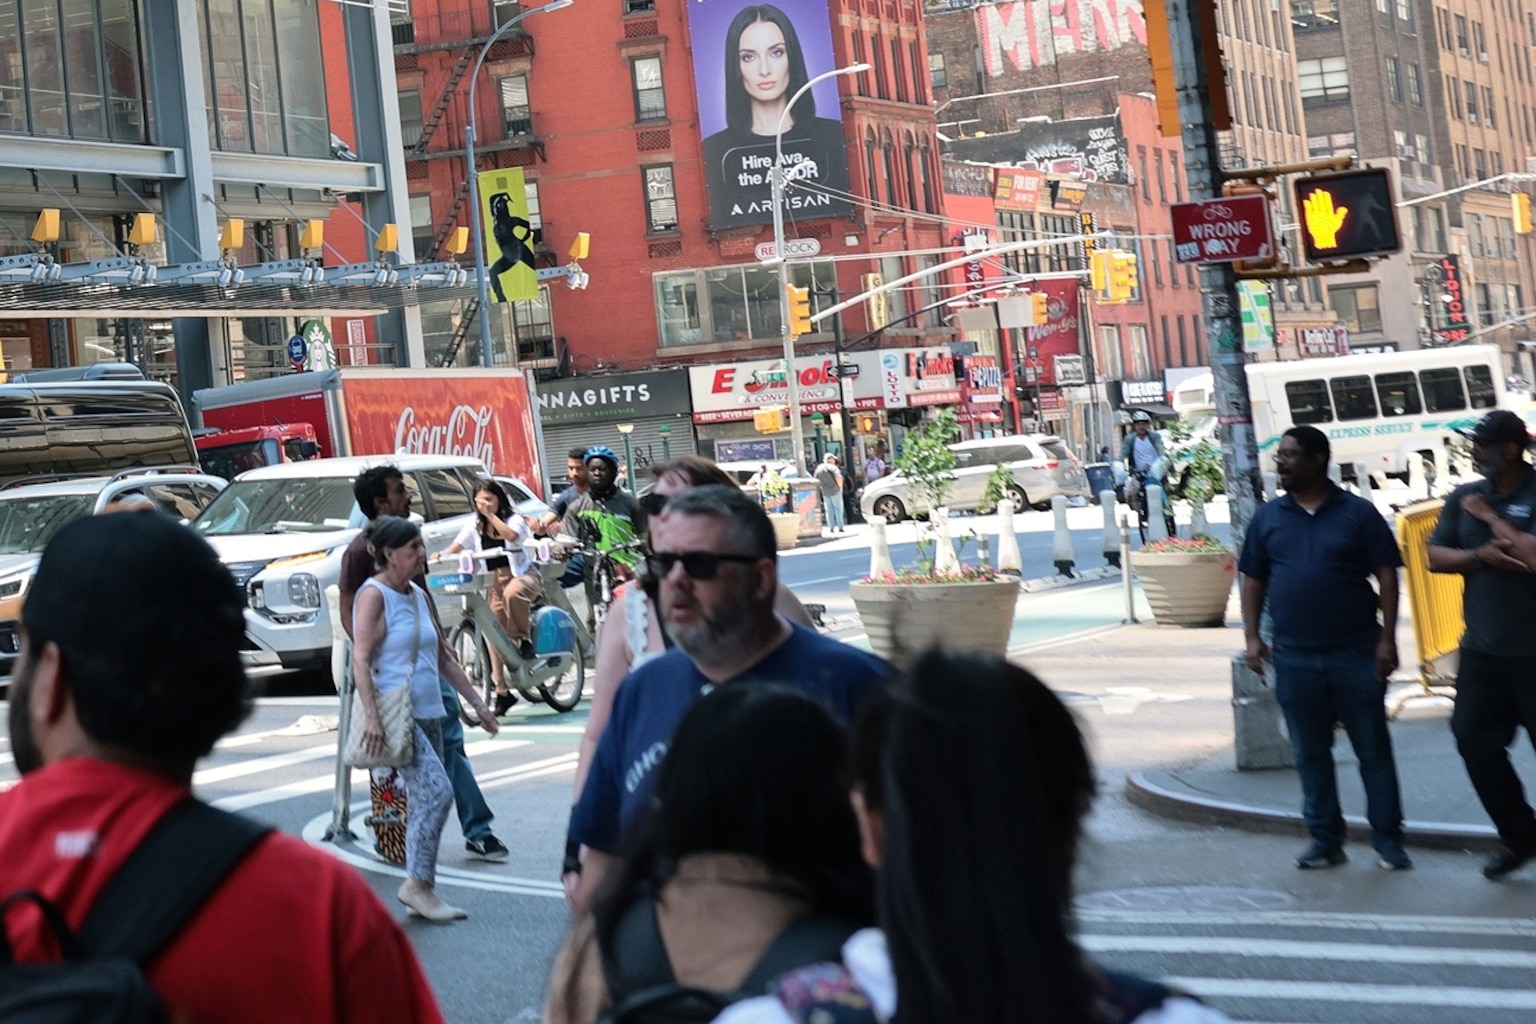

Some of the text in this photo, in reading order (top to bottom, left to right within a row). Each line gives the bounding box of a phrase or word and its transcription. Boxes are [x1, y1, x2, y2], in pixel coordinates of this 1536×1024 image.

[742, 155, 772, 170] Hire
[737, 172, 763, 186] the
[748, 194, 831, 214] ARISAN
[1189, 219, 1252, 241] WRONG
[1441, 258, 1465, 323] LIQUOR
[712, 368, 737, 394] E
[887, 371, 901, 403] LOTTO
[754, 389, 828, 404] CONVEIENCE
[563, 410, 584, 419] GIFTS
[594, 407, 636, 417] SOUVENIRS
